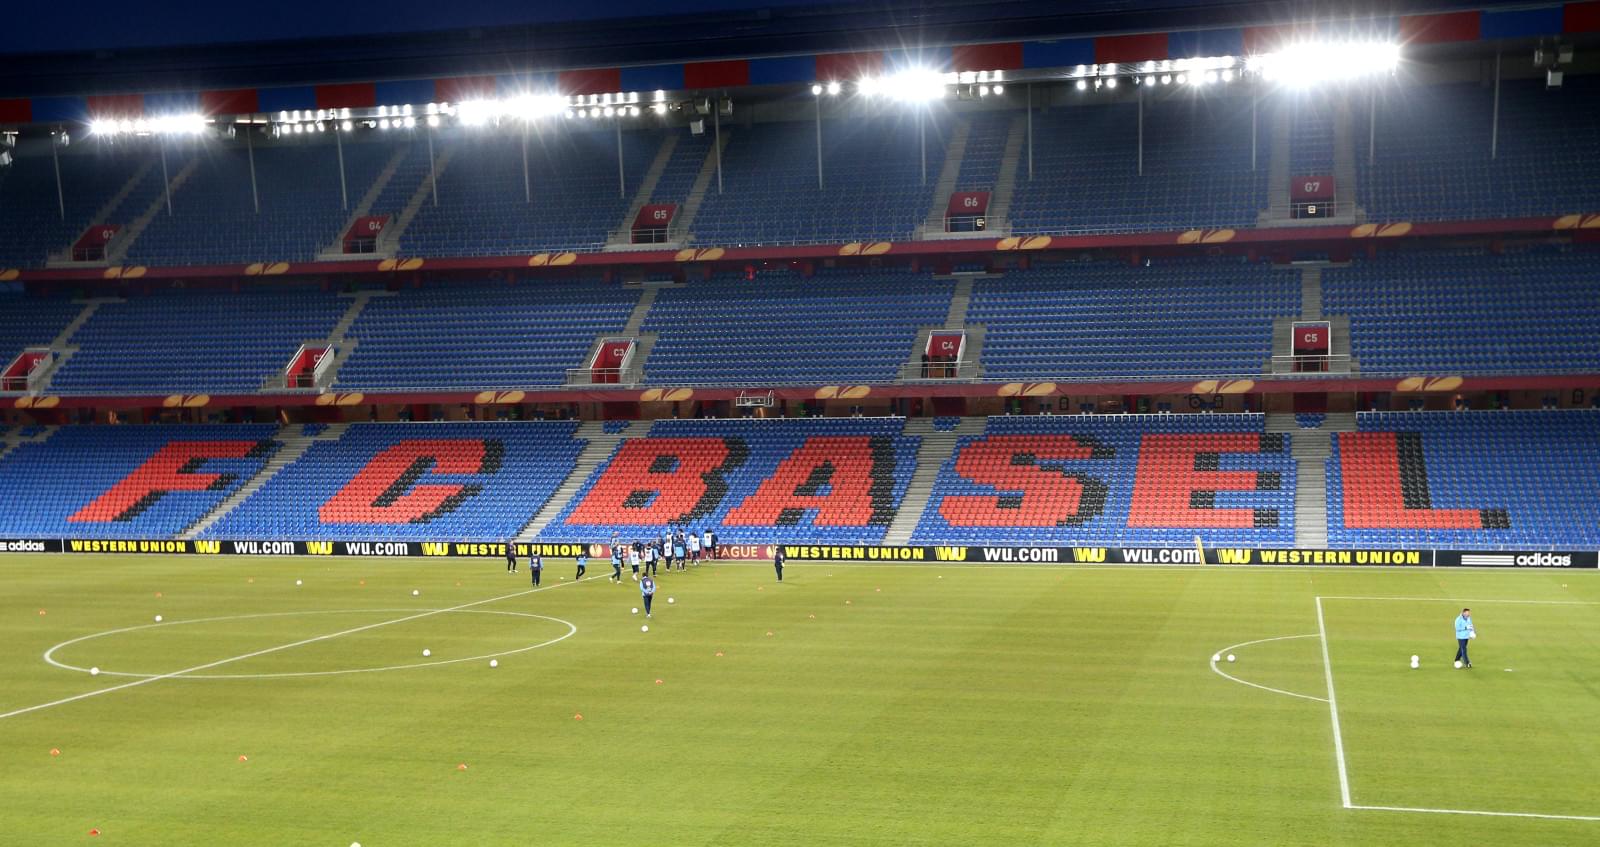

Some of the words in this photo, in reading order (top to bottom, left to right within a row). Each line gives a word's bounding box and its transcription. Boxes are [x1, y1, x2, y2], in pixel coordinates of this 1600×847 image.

[1305, 182, 1320, 192] G7
[964, 197, 979, 207] G6
[654, 210, 667, 219] G5
[369, 221, 381, 230] G4
[1304, 334, 1318, 343] C5
[941, 341, 954, 350] C4
[613, 348, 625, 356] C3
[8, 540, 45, 551] adidas
[71, 541, 137, 552] WESTERN
[140, 541, 186, 552] UNION
[234, 541, 295, 554] wu.com
[346, 542, 408, 555] wu.com
[531, 544, 583, 556] UNION
[785, 546, 865, 559] WESTERN
[869, 547, 924, 559] UNION
[984, 548, 1058, 561] wu.com
[1123, 549, 1200, 563] wu.com
[1260, 551, 1350, 564] WESTERN
[1356, 551, 1420, 564] UNION
[1516, 553, 1571, 566] adidas
